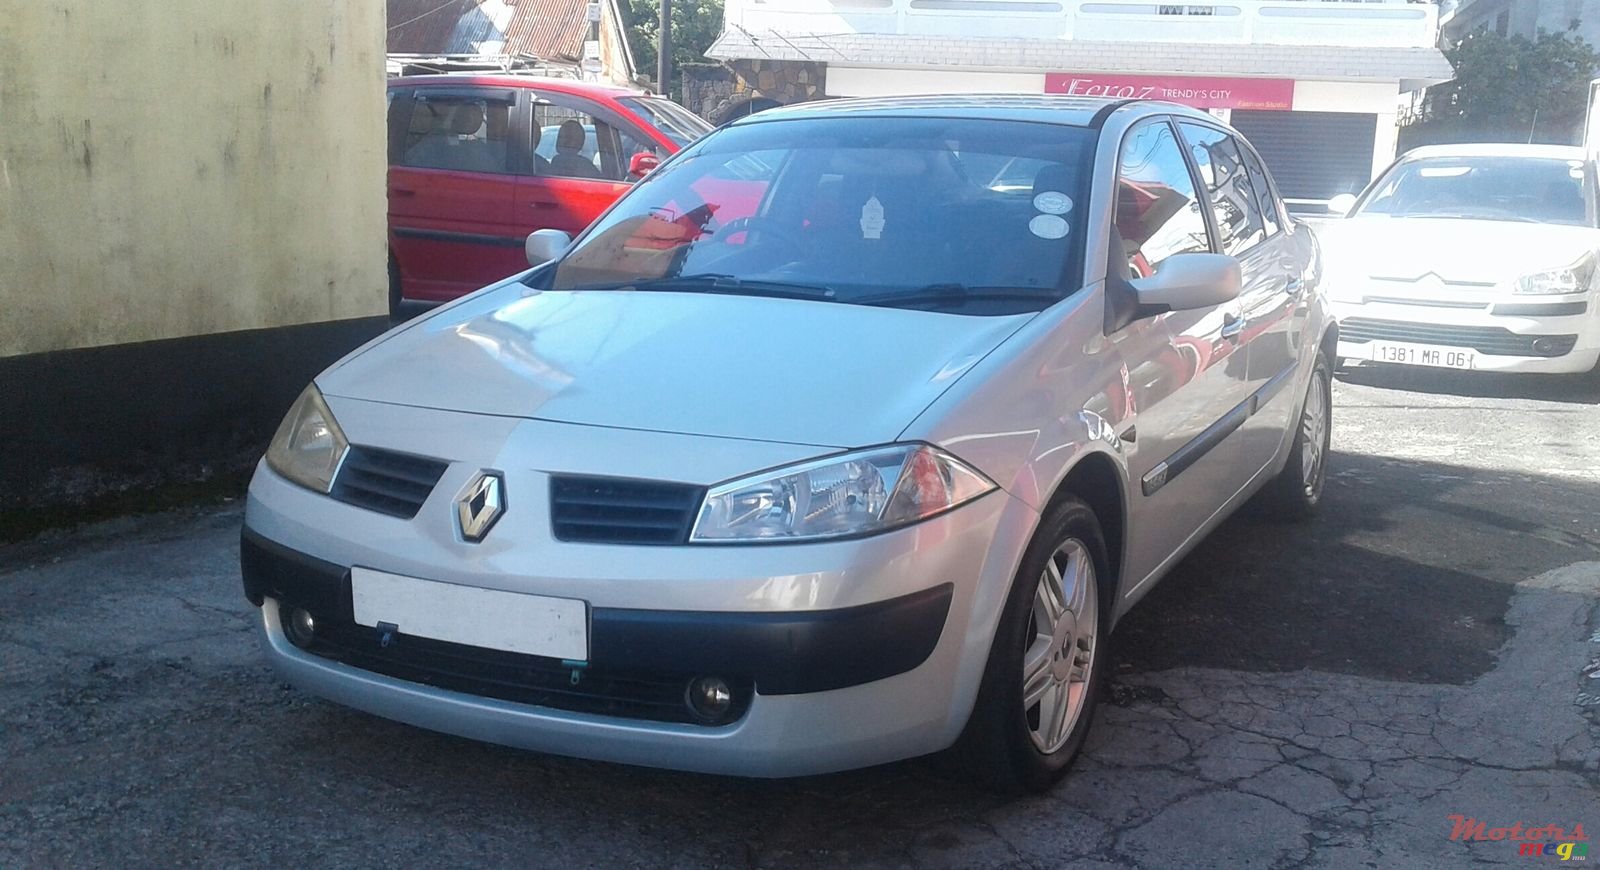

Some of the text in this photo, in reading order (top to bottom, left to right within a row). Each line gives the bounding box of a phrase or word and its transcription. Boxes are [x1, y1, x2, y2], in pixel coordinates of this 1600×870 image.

[1162, 88, 1232, 99] TRENDY'S CITY
[1381, 346, 1414, 363] 1381
[1422, 350, 1440, 365] MR
